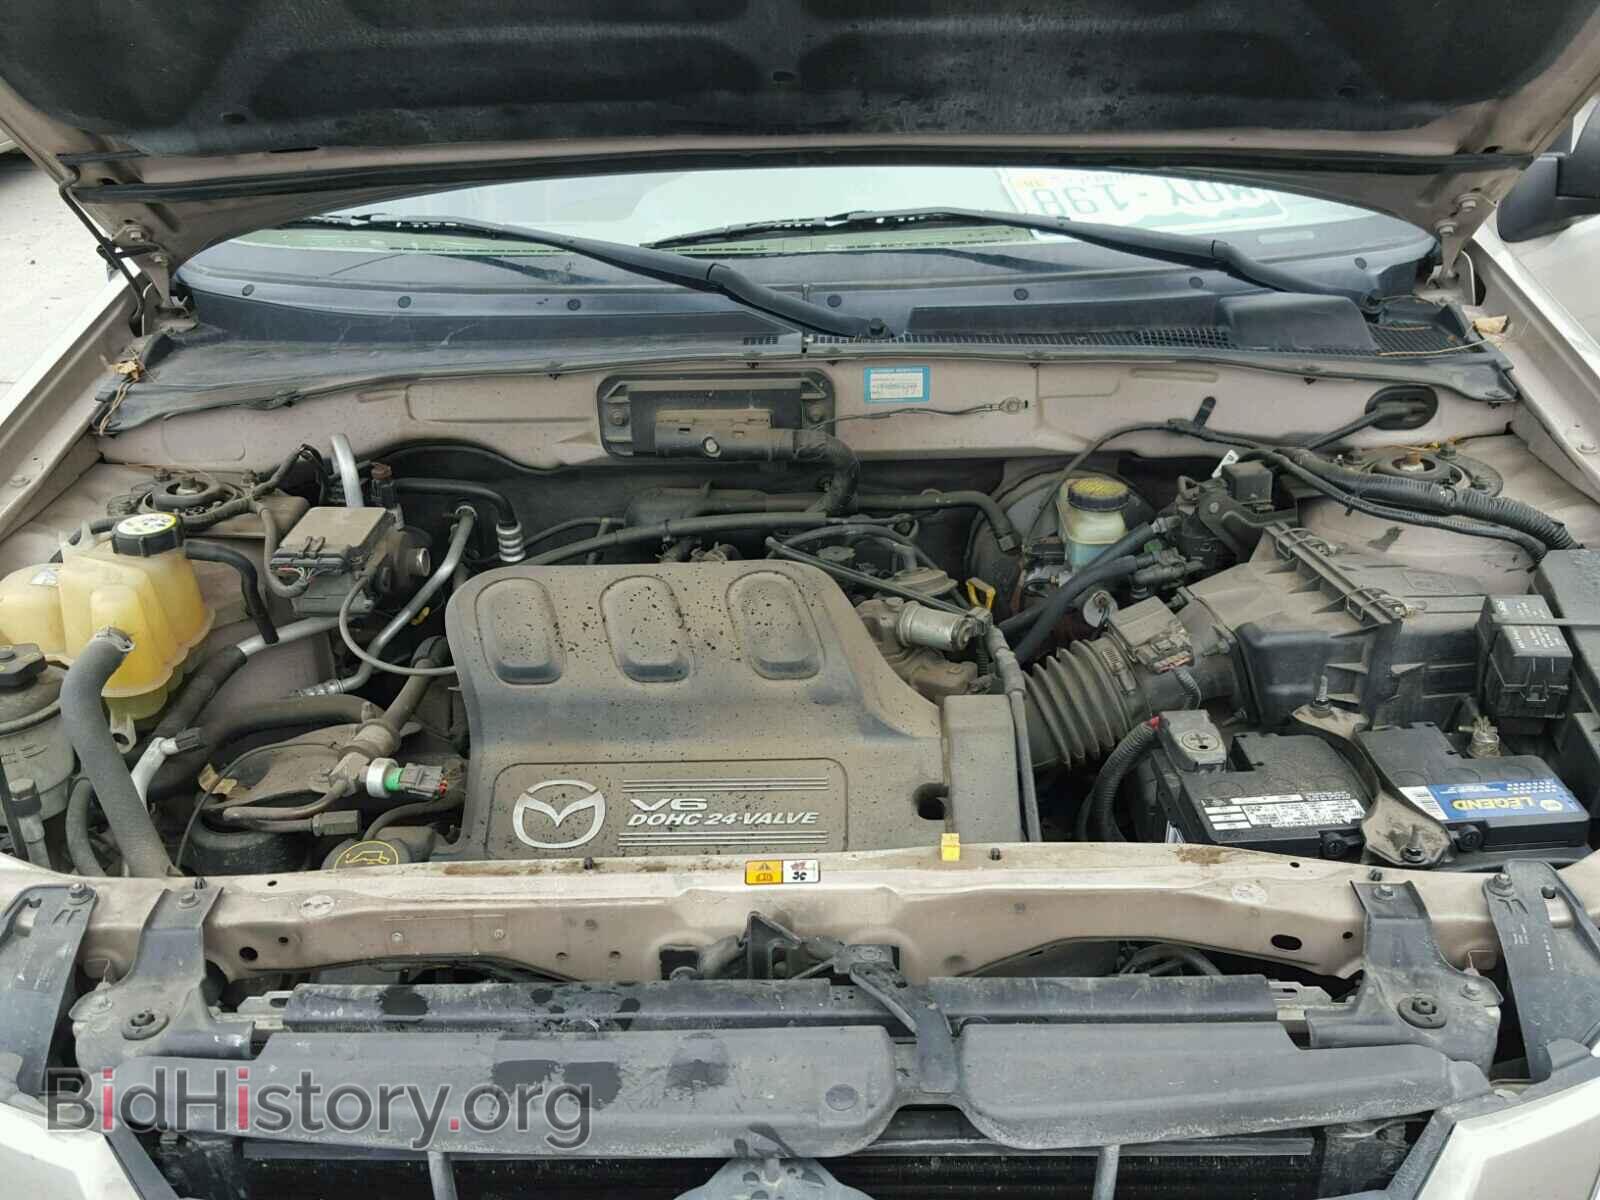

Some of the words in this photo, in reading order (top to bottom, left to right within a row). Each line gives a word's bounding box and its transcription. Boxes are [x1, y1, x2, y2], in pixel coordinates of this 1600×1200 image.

[630, 798, 708, 811] V6
[1451, 796, 1532, 811] LEGEND
[627, 812, 703, 826] DOHC
[703, 811, 819, 825] 24-VALVE
